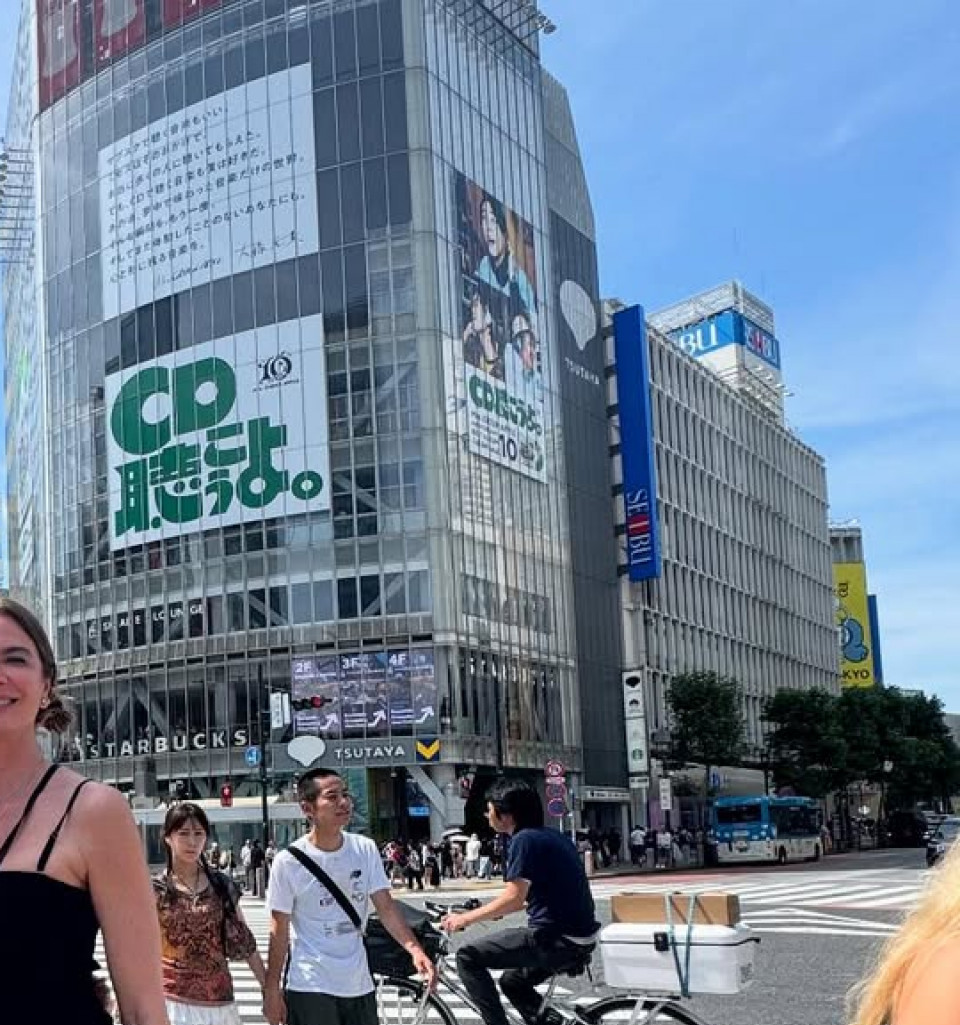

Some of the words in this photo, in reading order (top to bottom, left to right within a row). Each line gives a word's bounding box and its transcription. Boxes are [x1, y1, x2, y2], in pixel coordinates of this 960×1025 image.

[627, 488, 652, 566] SEIBU
[90, 730, 248, 758] STARBUCKS
[334, 745, 406, 760] TSUTAYA
